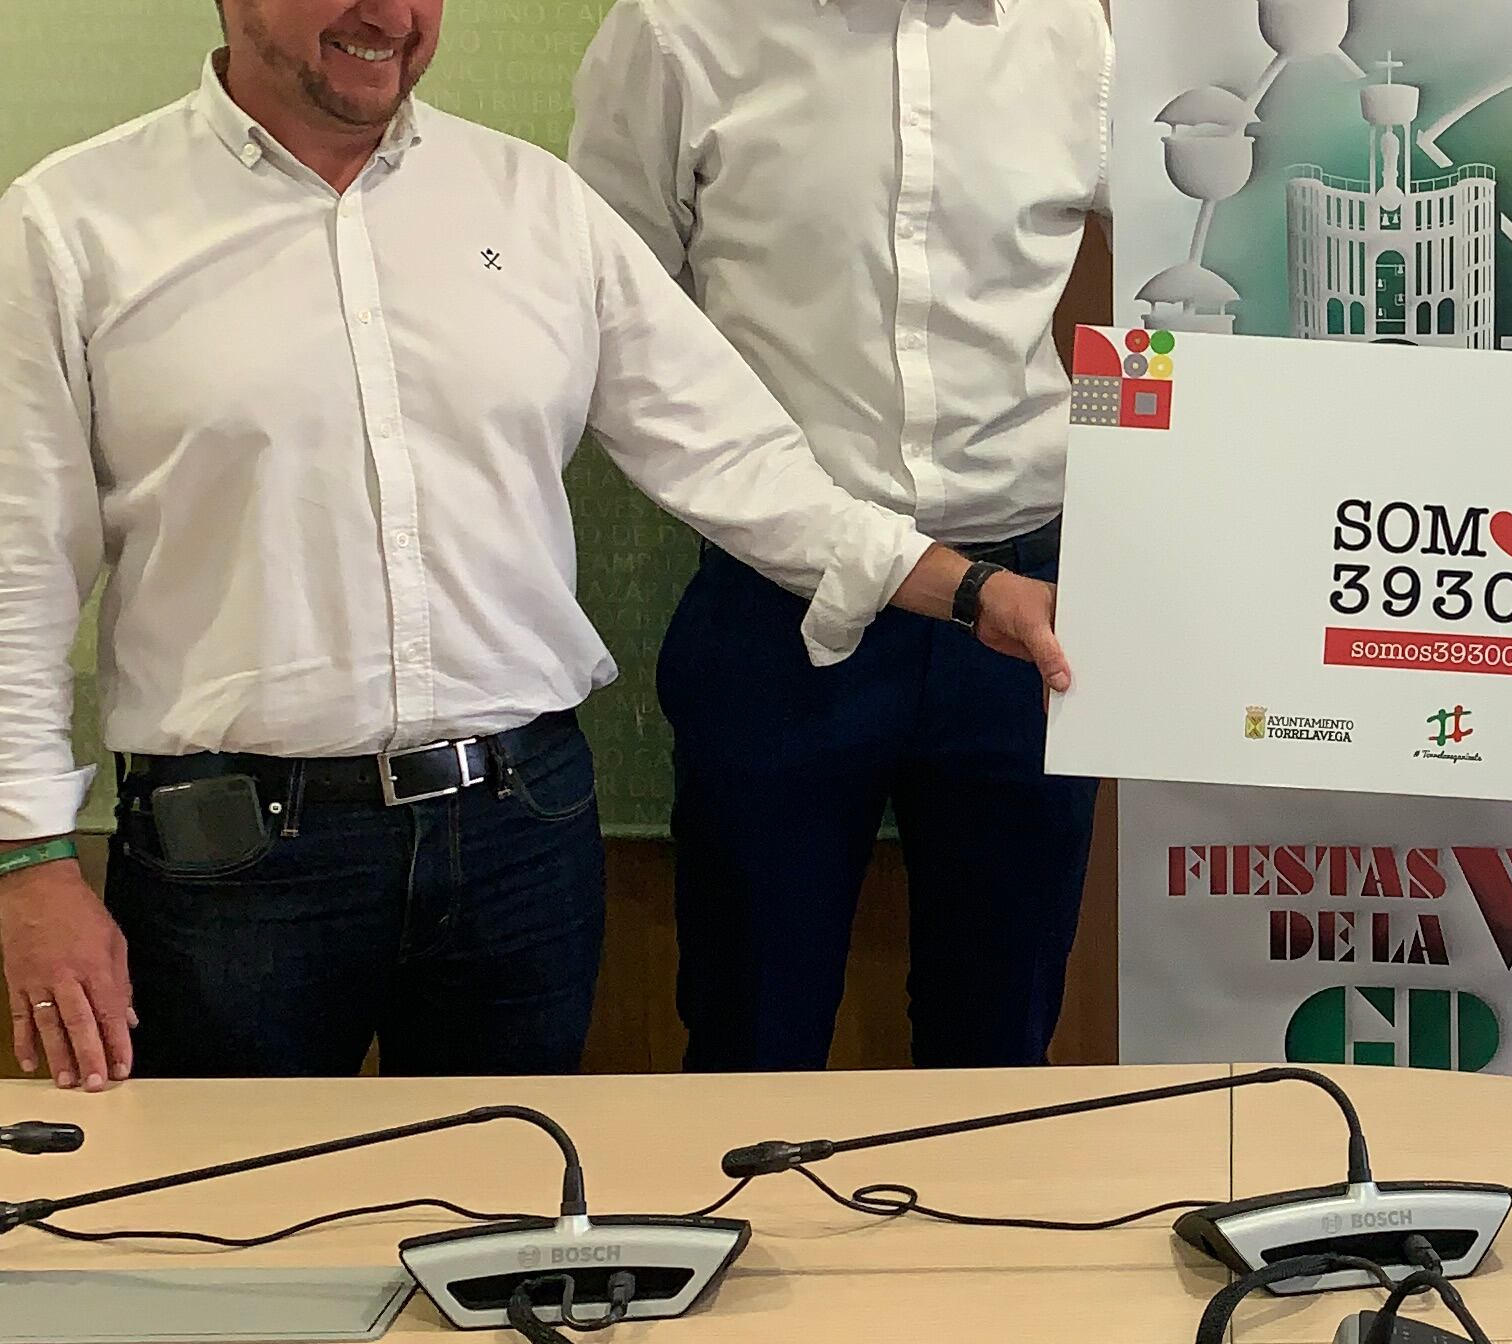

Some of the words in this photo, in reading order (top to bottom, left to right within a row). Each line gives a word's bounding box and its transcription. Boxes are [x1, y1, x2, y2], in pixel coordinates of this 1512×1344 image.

[1267, 715, 1354, 731] AYUNTAMIENTO
[1267, 727, 1352, 743] TORRELAVEGA
[1168, 844, 1447, 901] FIESTAS
[1269, 910, 1356, 962] DE
[1370, 910, 1450, 966] LA
[1352, 1210, 1412, 1229] BOSCH
[551, 1245, 621, 1264] BOSCH
